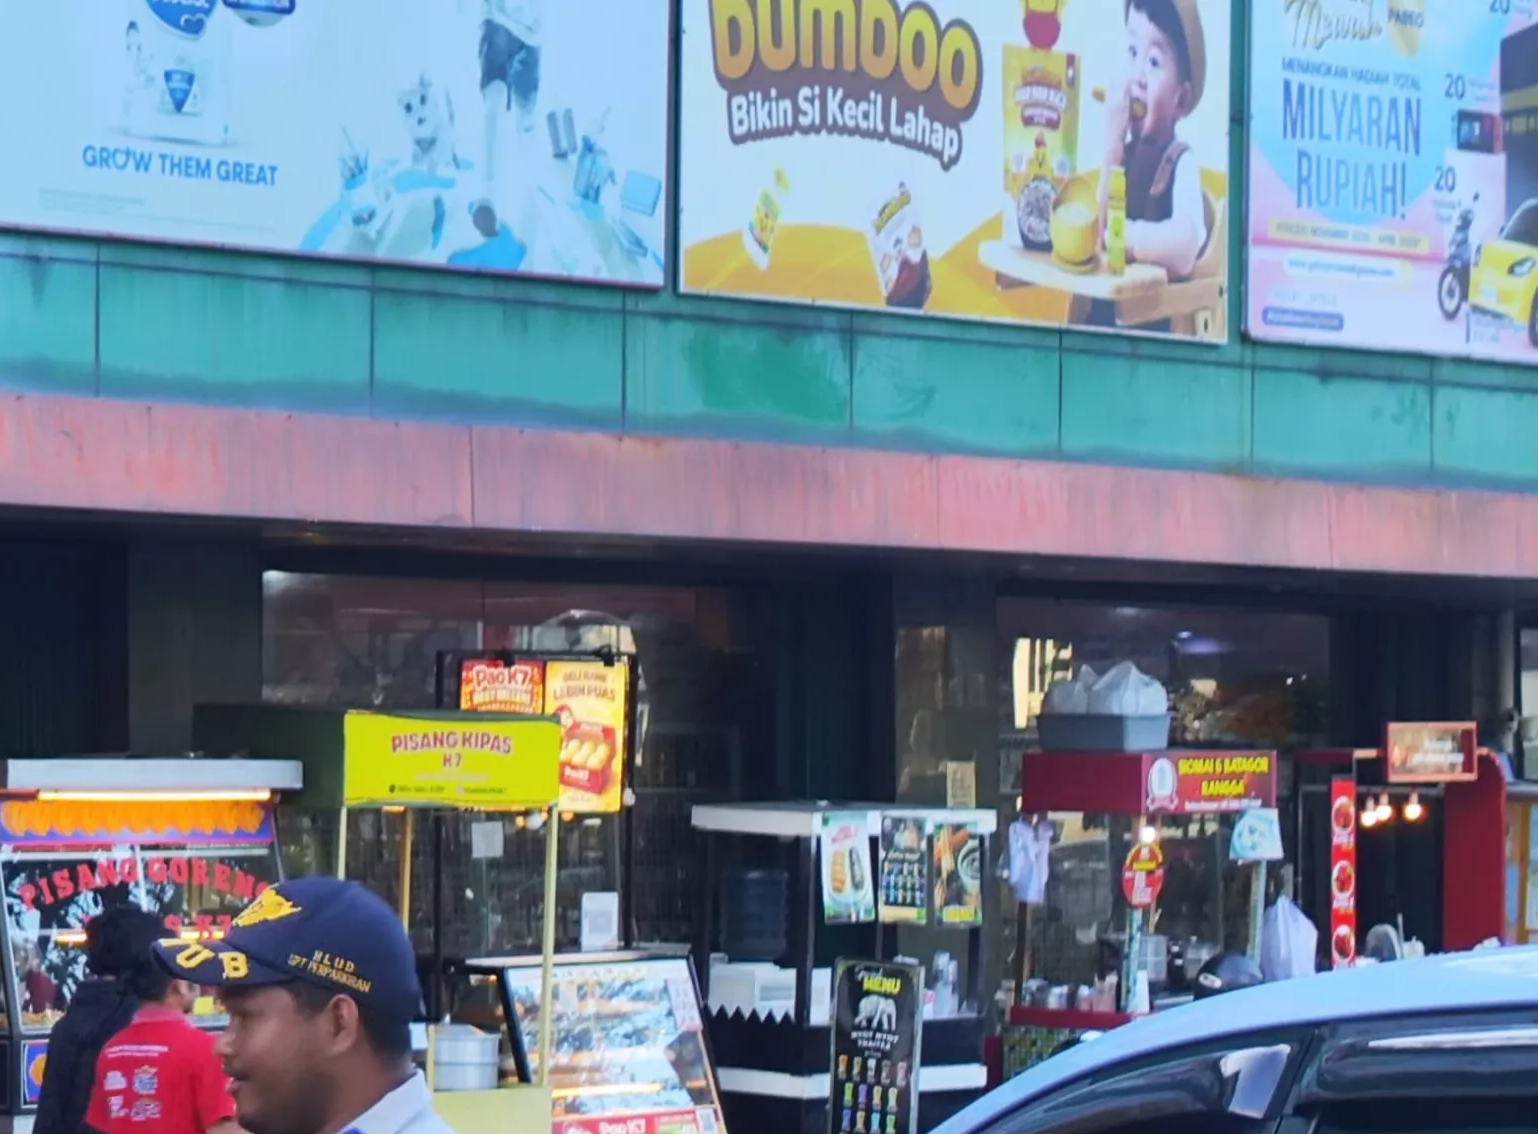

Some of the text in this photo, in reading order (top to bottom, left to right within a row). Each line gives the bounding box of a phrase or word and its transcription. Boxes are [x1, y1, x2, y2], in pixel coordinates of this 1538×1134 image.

[1282, 57, 1349, 79] MENANGKAN
[1444, 73, 1466, 100] 20
[730, 88, 794, 136] Bikin
[797, 84, 821, 127] Si
[827, 86, 885, 134] Kecil
[889, 96, 960, 165] Lahap
[1282, 78, 1421, 157] MILYARAN
[81, 145, 278, 187] GROW THEM GREAT
[1296, 149, 1406, 221] RUPIAH!
[1434, 165, 1456, 193] 20
[391, 731, 512, 755] PISANG KIPAS
[19, 857, 141, 911] PISANG
